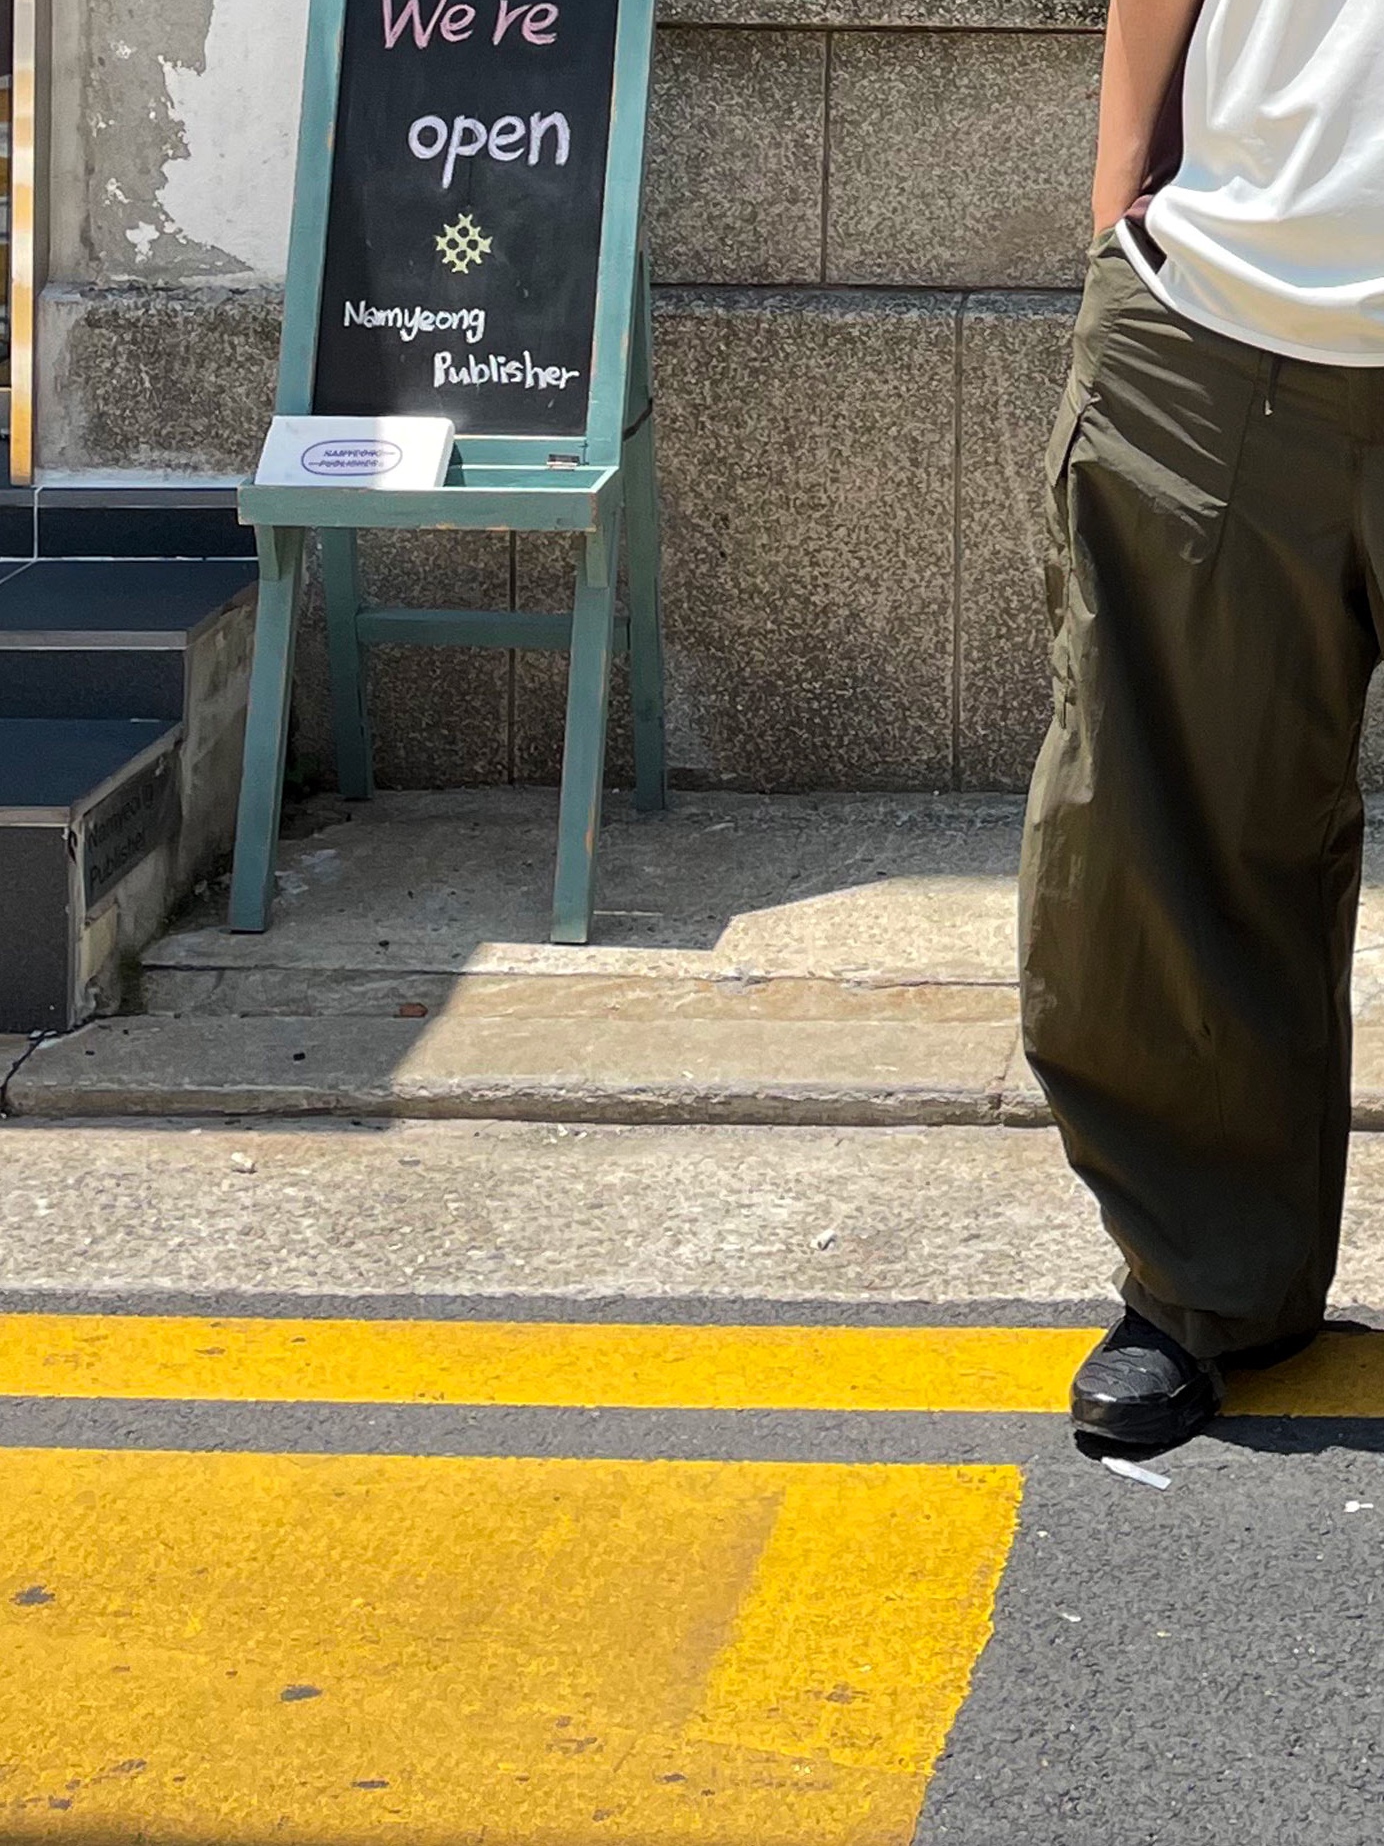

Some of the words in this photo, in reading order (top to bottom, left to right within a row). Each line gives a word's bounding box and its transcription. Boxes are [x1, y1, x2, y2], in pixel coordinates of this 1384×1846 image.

[408, 110, 571, 189] open
[343, 300, 486, 344] Namyeong
[433, 350, 580, 391] Publisher
